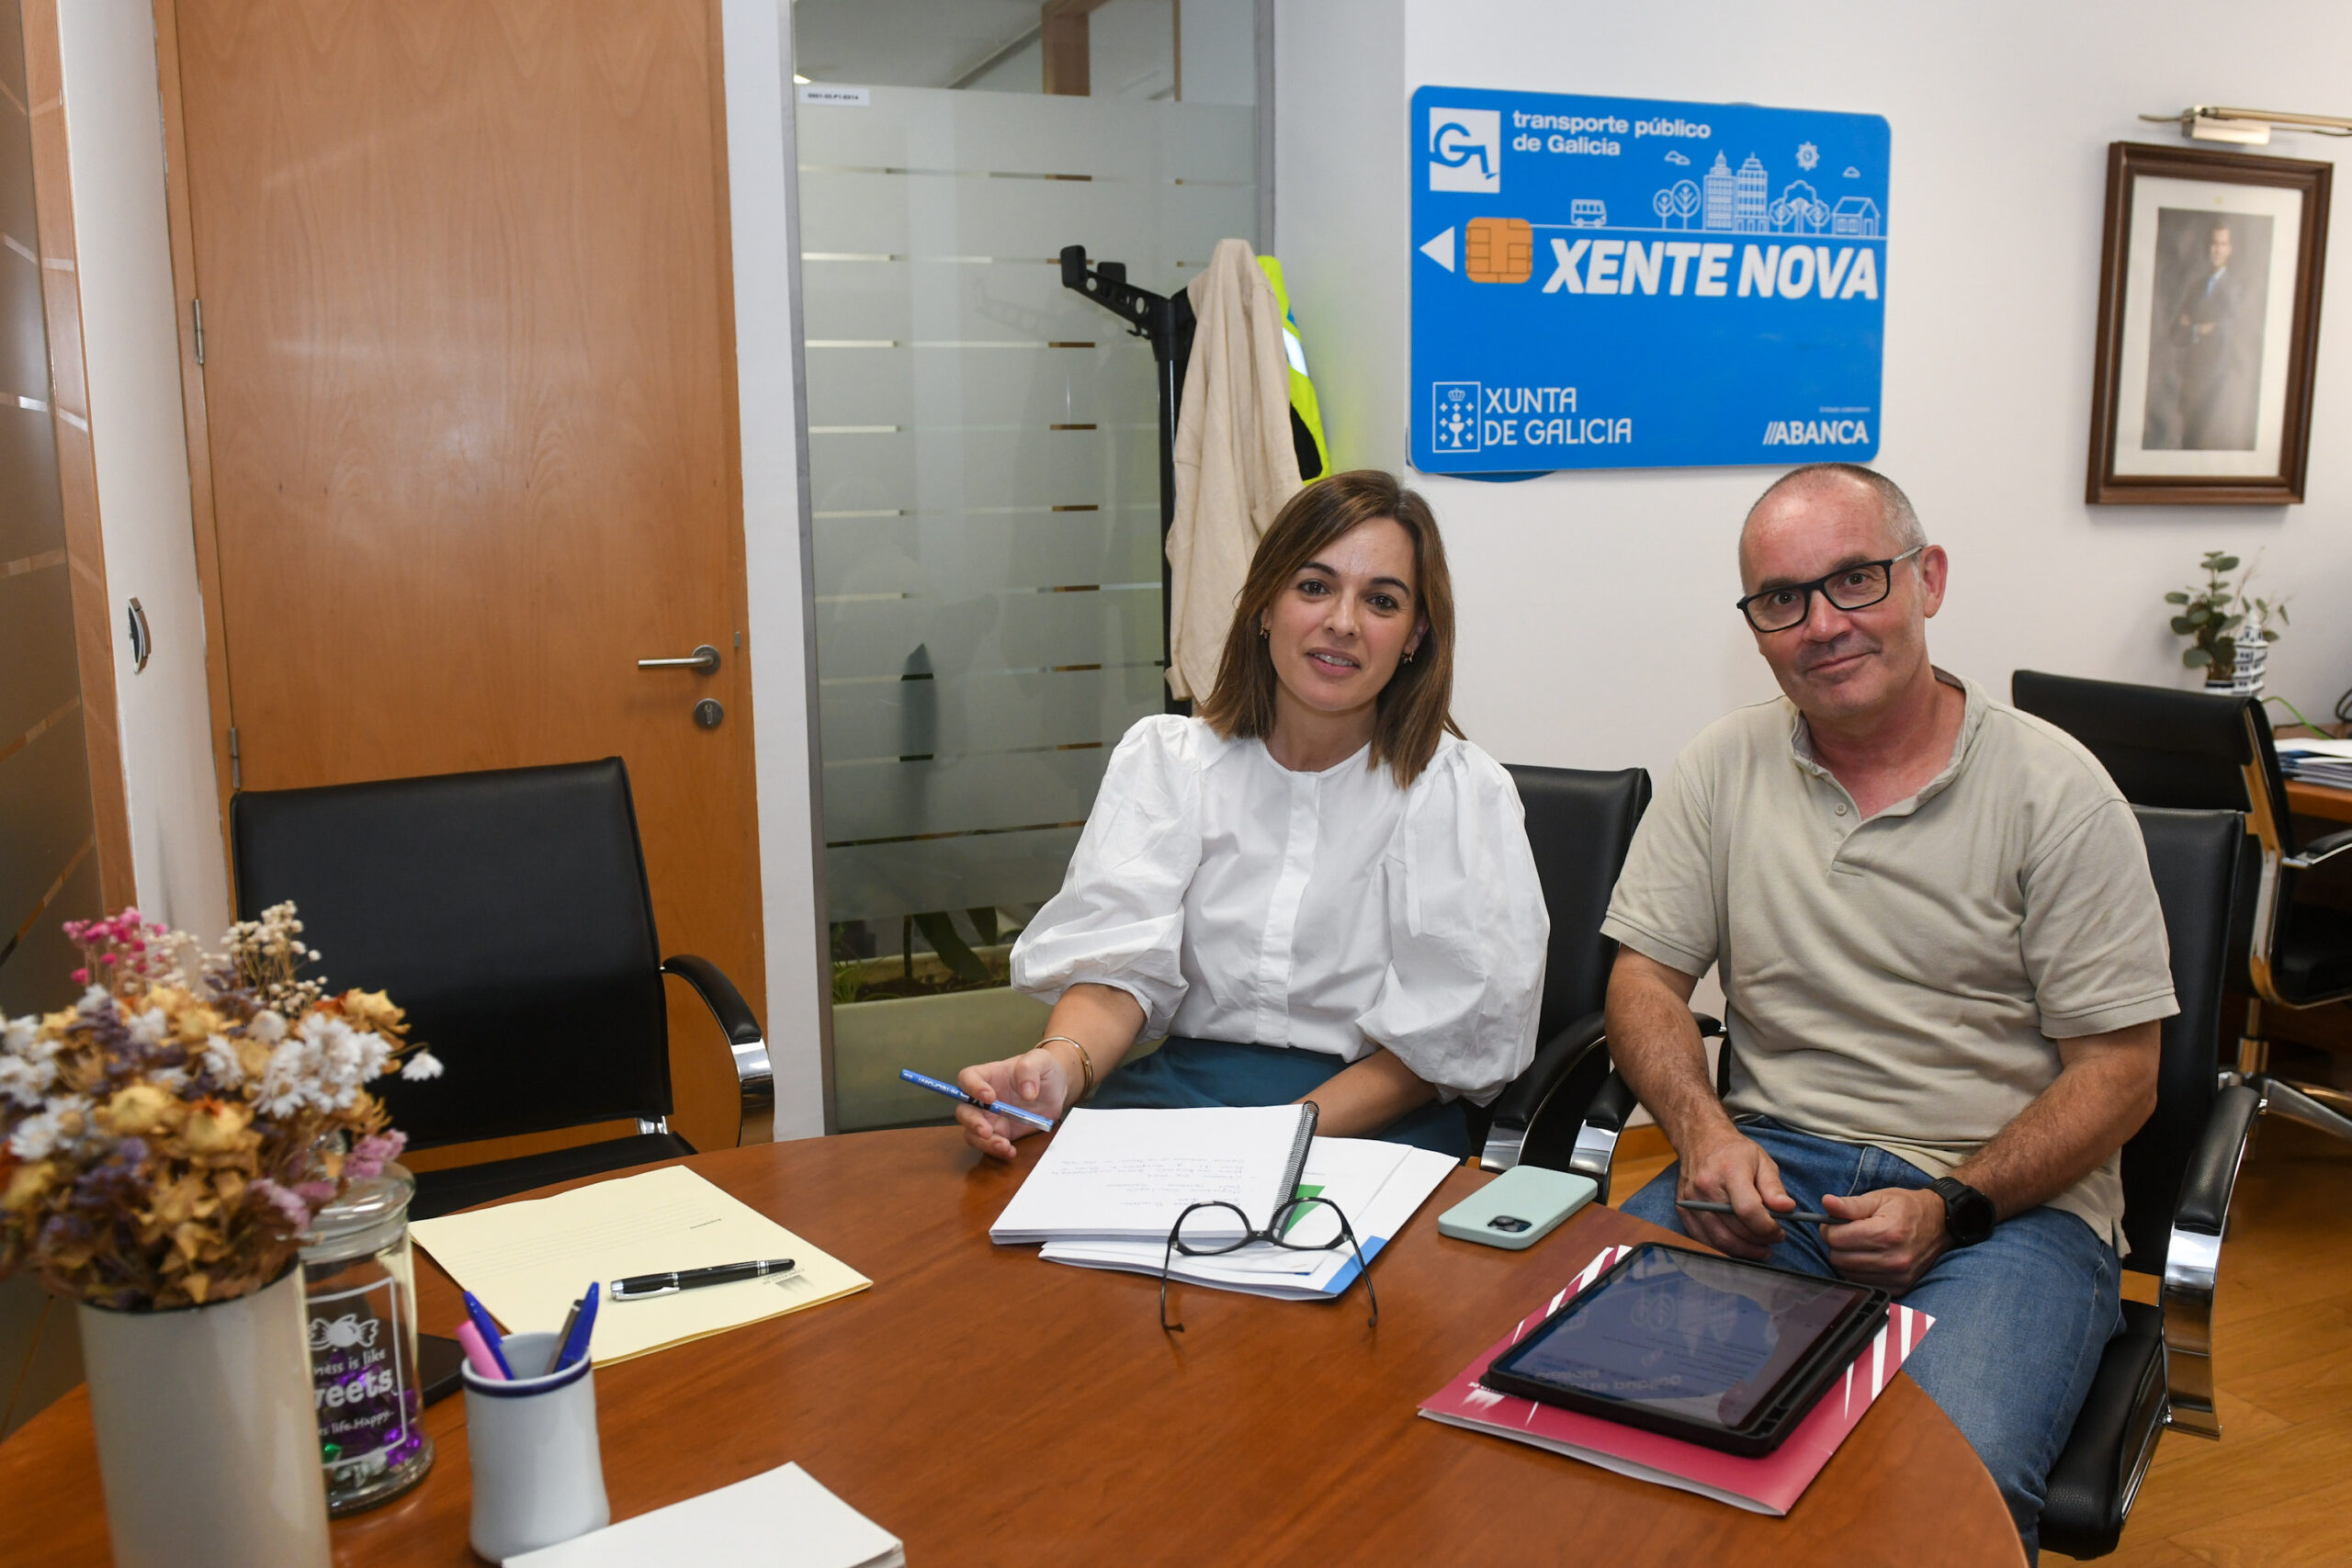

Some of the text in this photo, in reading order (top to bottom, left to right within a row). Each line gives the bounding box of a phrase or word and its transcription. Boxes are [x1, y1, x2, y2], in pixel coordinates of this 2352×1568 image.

[1512, 109, 1712, 139] transporte público
[1512, 133, 1622, 156] de Galicia
[1542, 238, 1879, 300] XENTE NOVA
[1485, 388, 1577, 413] XUNTA
[1484, 418, 1632, 446] DE GALICIA
[348, 1356, 359, 1370] is
[362, 1348, 386, 1366] like
